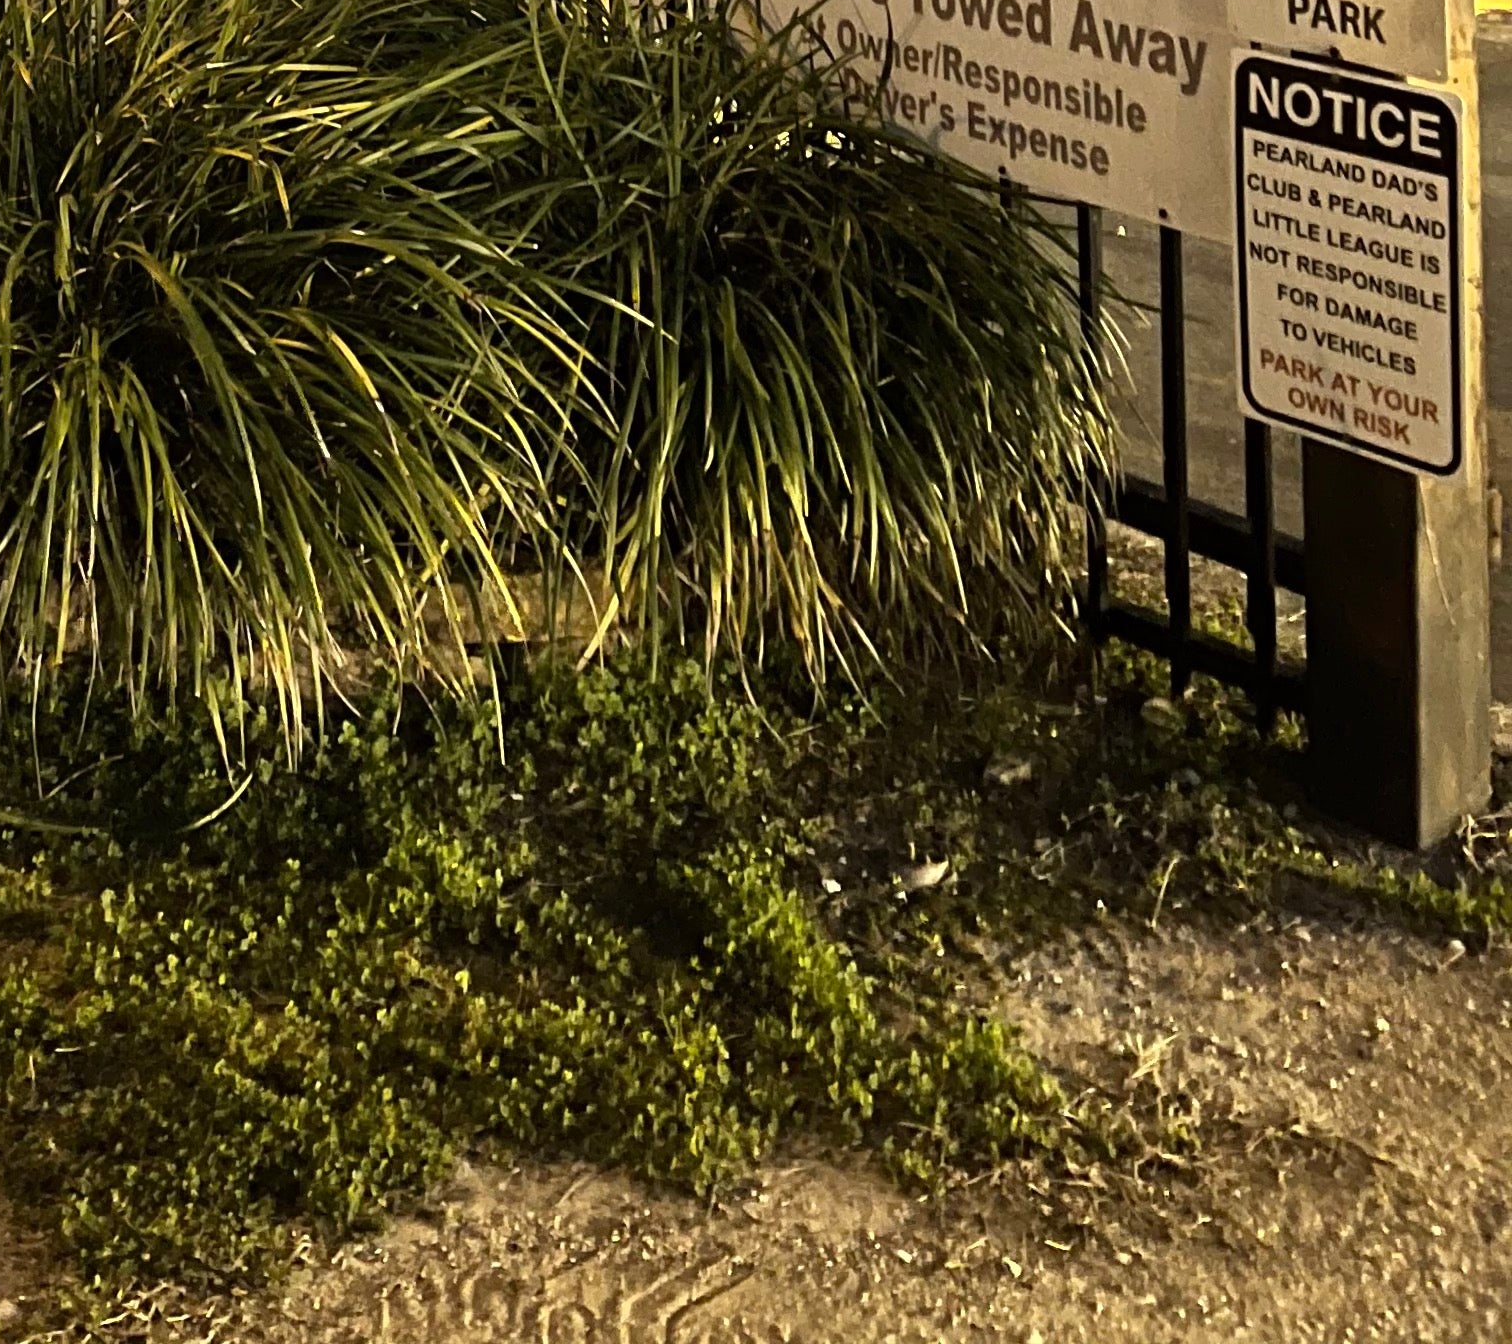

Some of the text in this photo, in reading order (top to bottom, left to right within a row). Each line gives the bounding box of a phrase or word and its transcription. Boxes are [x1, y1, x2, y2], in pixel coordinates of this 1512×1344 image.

[836, 18, 1147, 135] Owner/Responsible
[1070, 0, 1208, 96] Away
[968, 101, 1111, 176] Expense
[1248, 72, 1441, 159] NOTICE
[1253, 139, 1438, 203] PEARLAND DAD'S
[1247, 173, 1446, 240] CLUB & PEARLAND
[1253, 209, 1440, 275] LITTLE LEAGUE IS
[1249, 242, 1447, 314] NOT RESPONSIBLE
[1277, 283, 1418, 341] FOR DAMAGE
[1280, 318, 1416, 376] TO VEHICLES
[1260, 348, 1439, 424] PARK AT YOUR
[1289, 386, 1411, 444] OWN RISK
